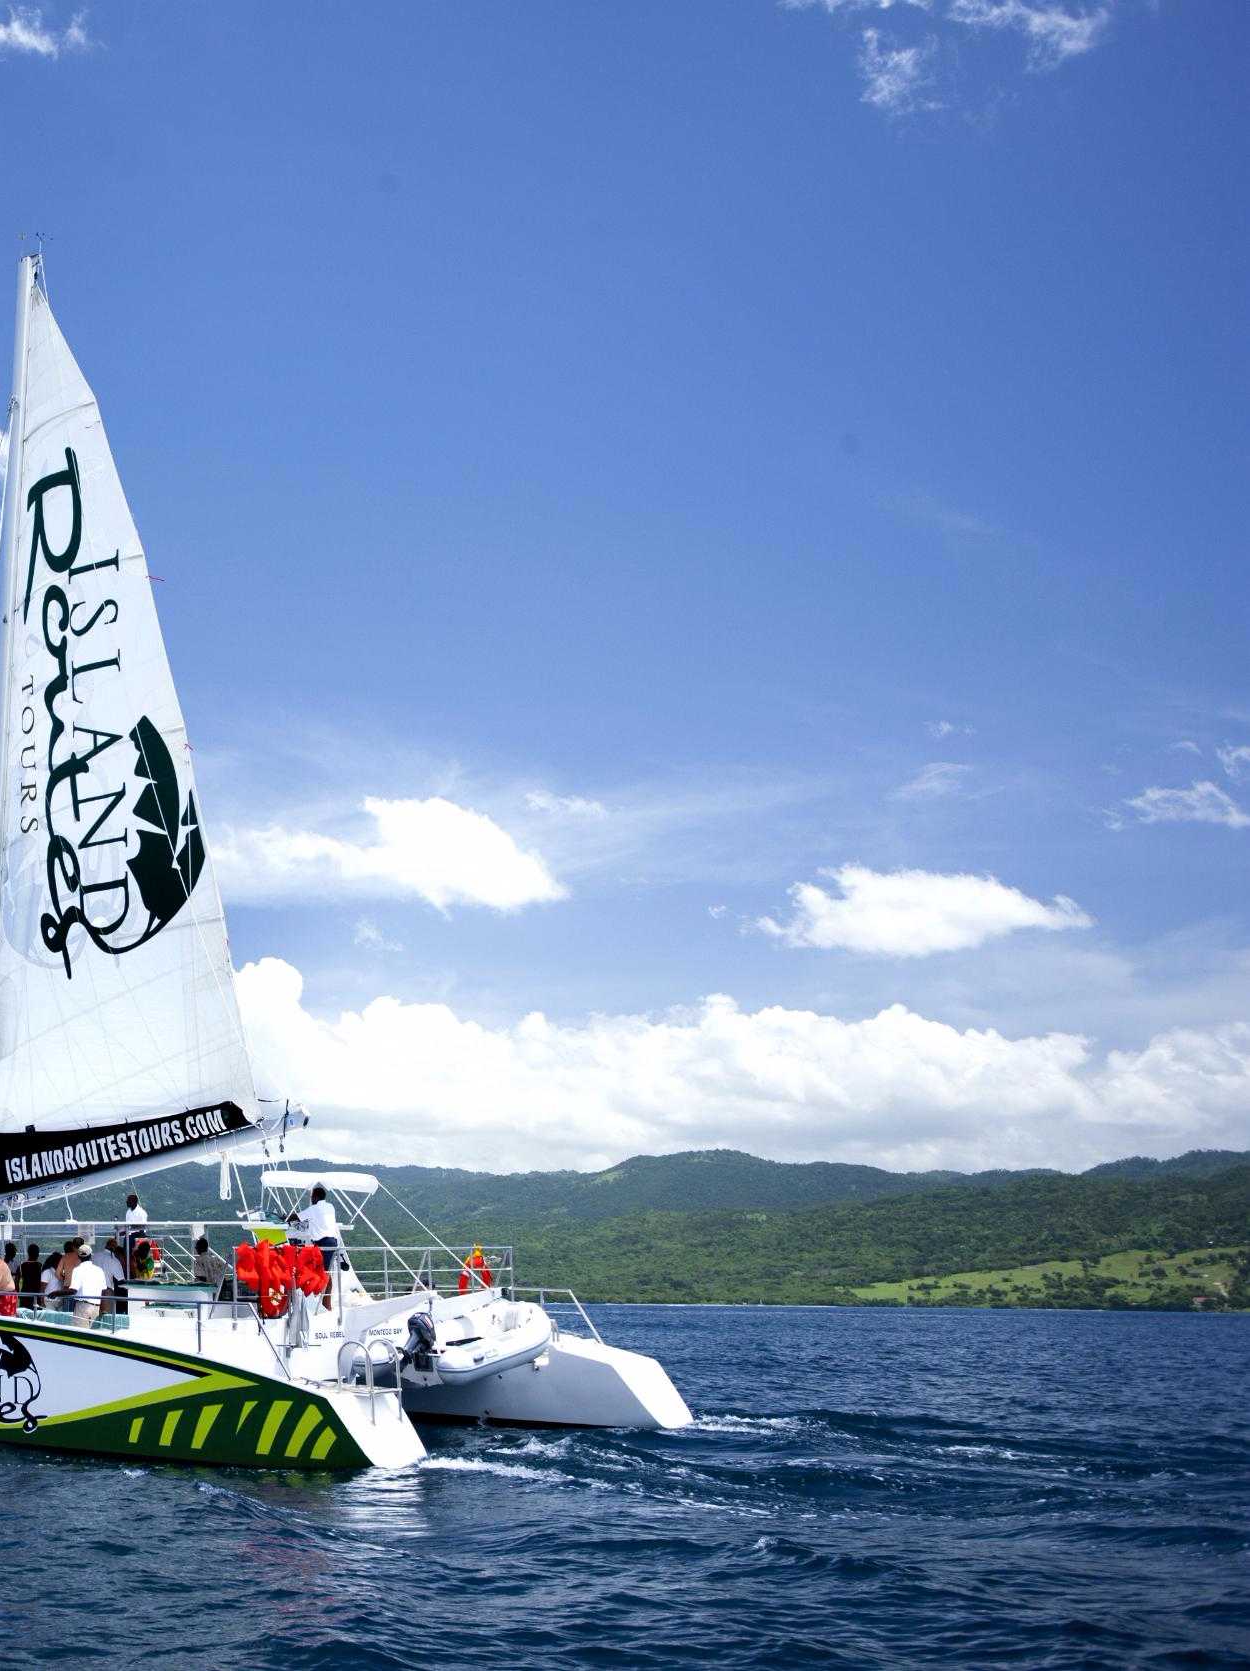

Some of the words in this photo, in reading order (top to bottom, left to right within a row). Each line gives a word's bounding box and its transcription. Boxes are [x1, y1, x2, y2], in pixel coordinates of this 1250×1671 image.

[19, 674, 39, 835] TOURS
[24, 447, 84, 979] Routes
[68, 548, 130, 936] ISLAND
[5, 1109, 227, 1184] ISLANDROUTESTOURS.COM
[315, 1332, 328, 1340] SOUL
[393, 1327, 403, 1335] BAY
